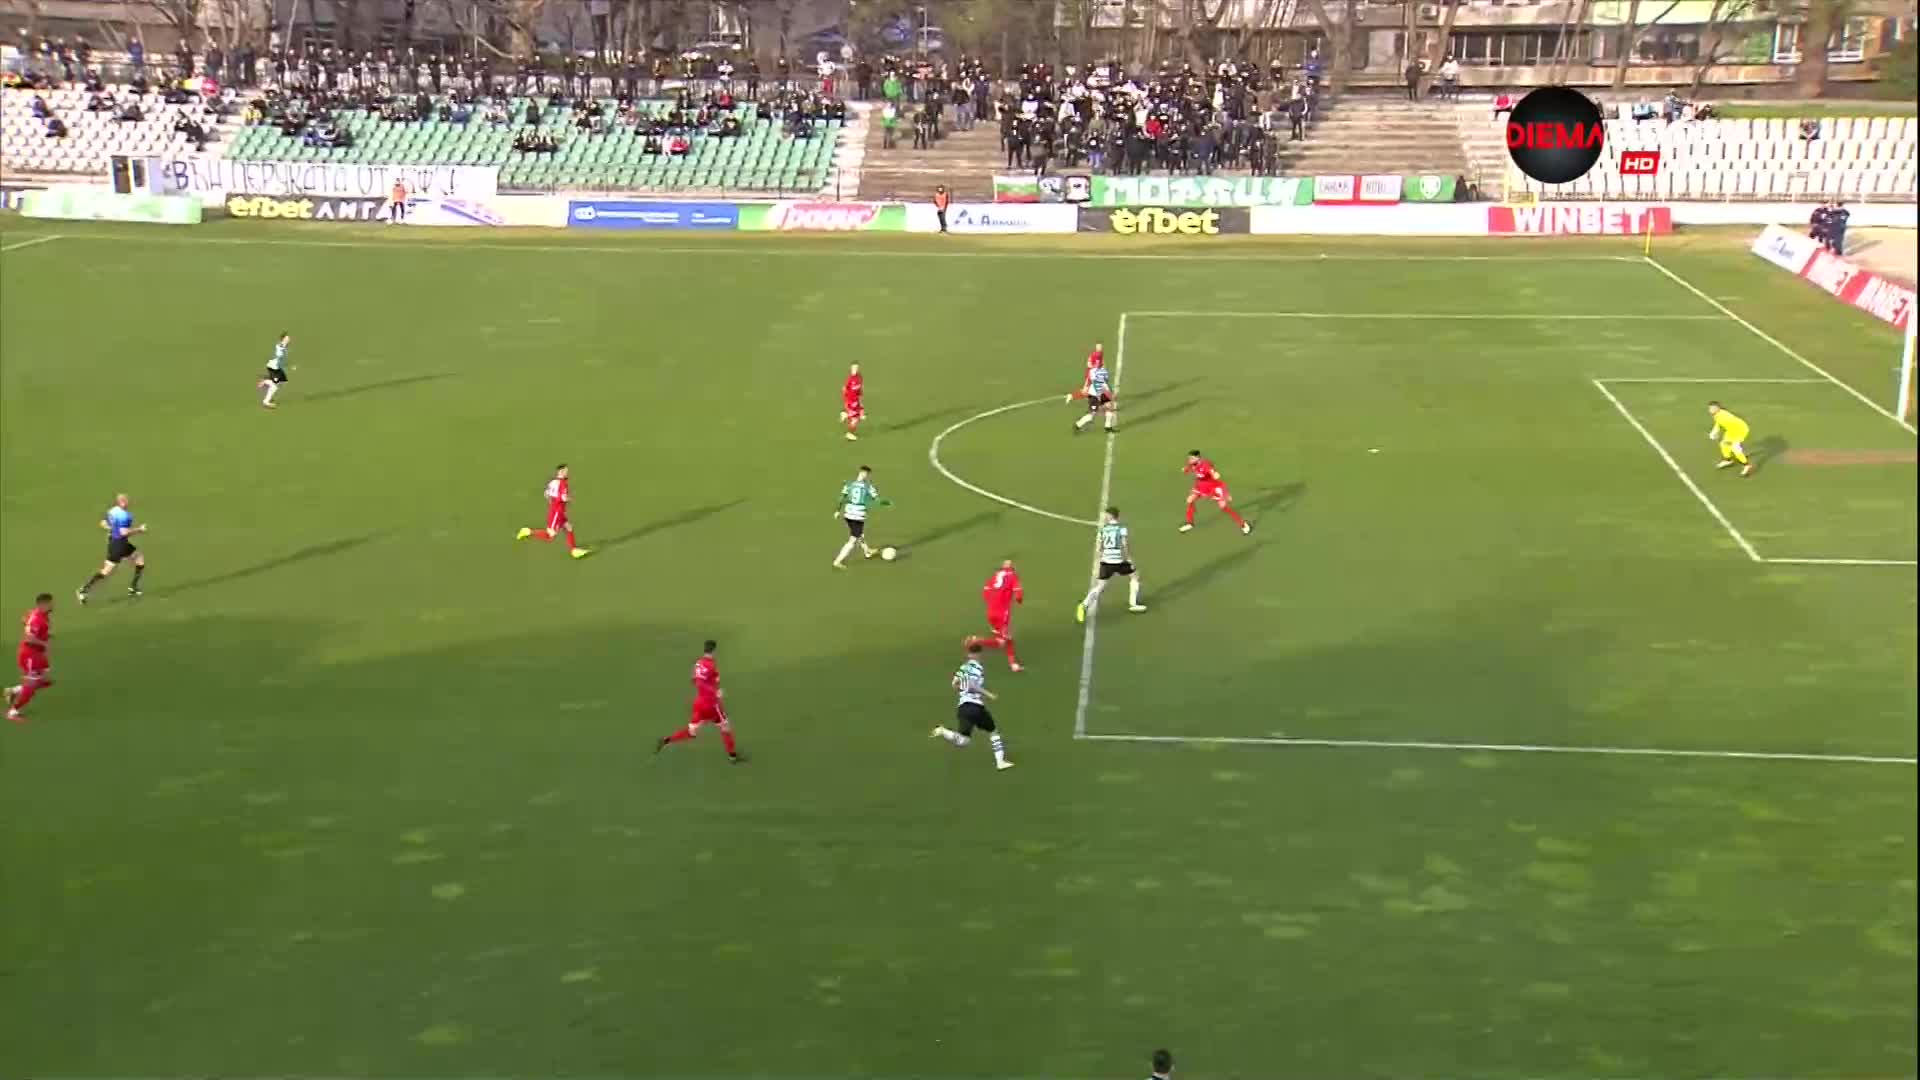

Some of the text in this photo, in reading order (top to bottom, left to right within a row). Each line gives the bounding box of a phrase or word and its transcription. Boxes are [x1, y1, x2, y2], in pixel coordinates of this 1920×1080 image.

[228, 196, 314, 219] efbet
[1110, 207, 1220, 235] efbet
[1512, 207, 1648, 234] WINBET
